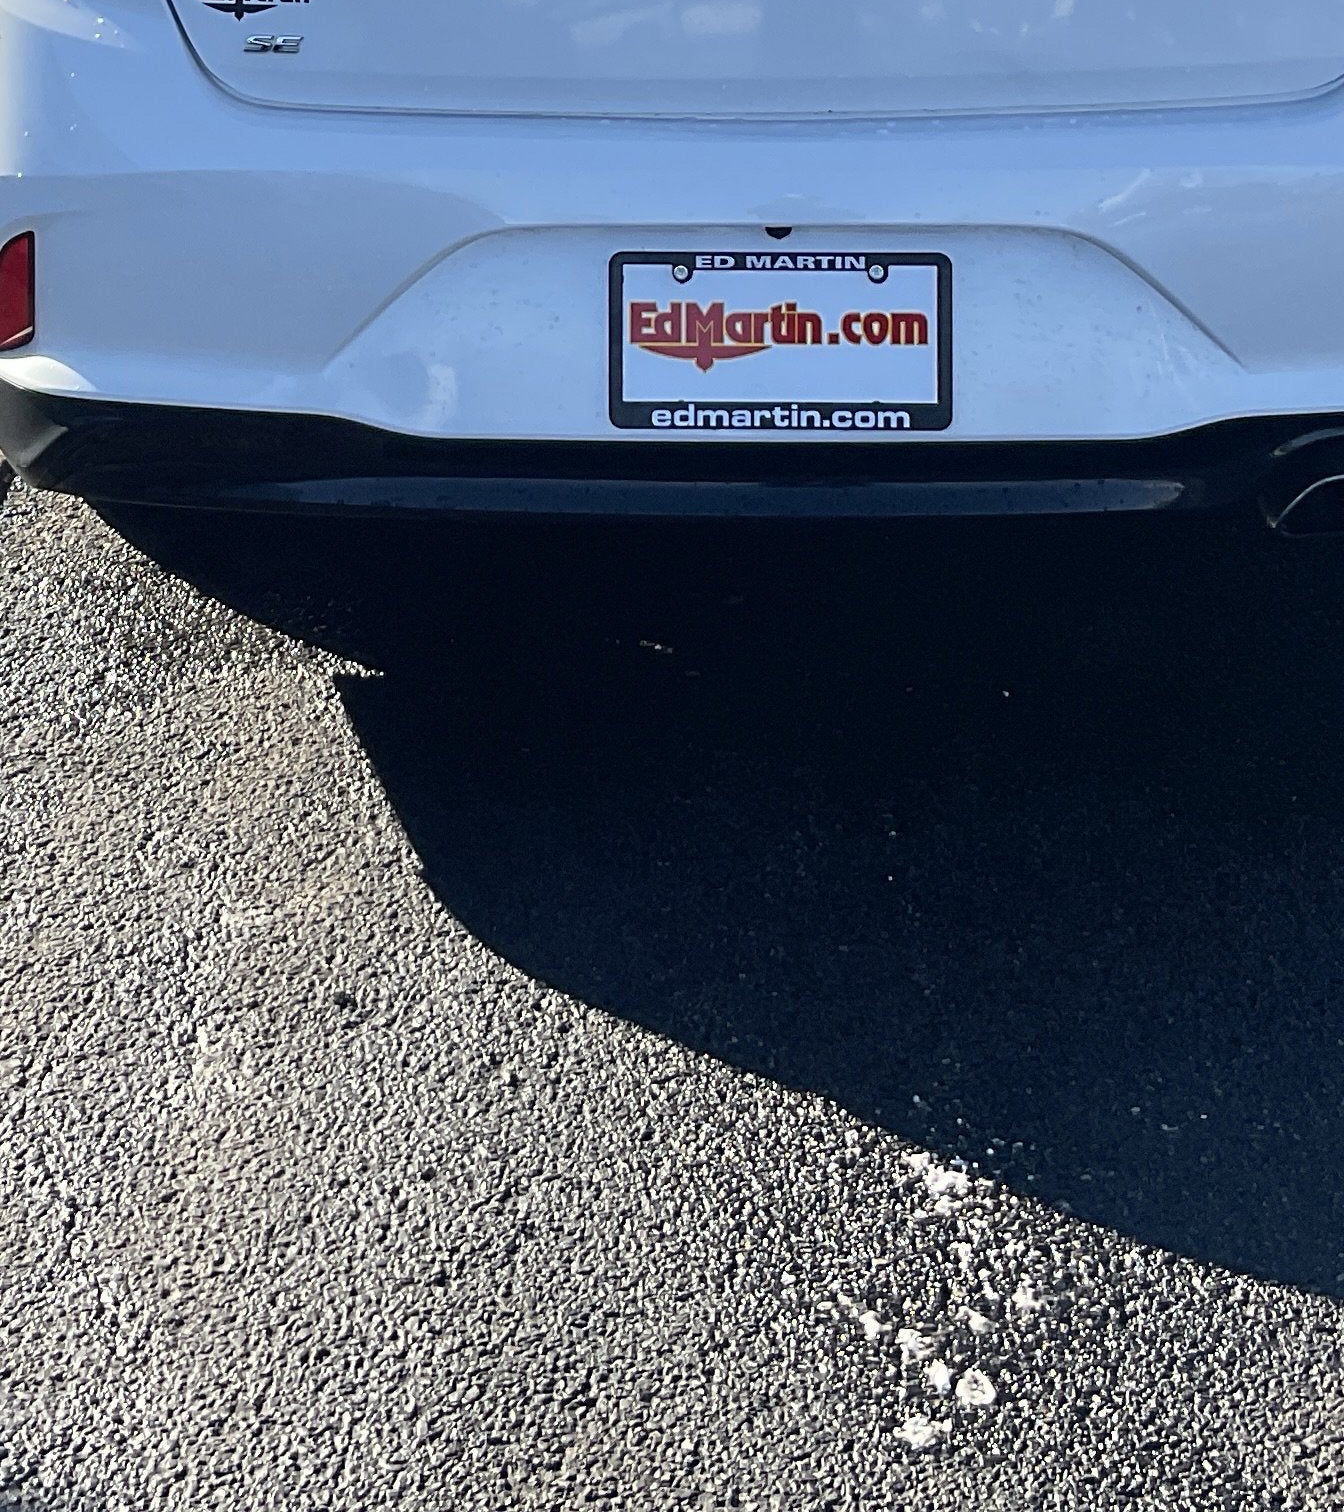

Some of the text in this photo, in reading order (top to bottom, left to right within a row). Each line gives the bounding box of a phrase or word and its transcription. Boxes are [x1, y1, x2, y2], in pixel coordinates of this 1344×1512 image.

[243, 34, 305, 54] SE
[695, 255, 867, 270] ED MARTIN
[651, 403, 911, 429] edmartin.com
